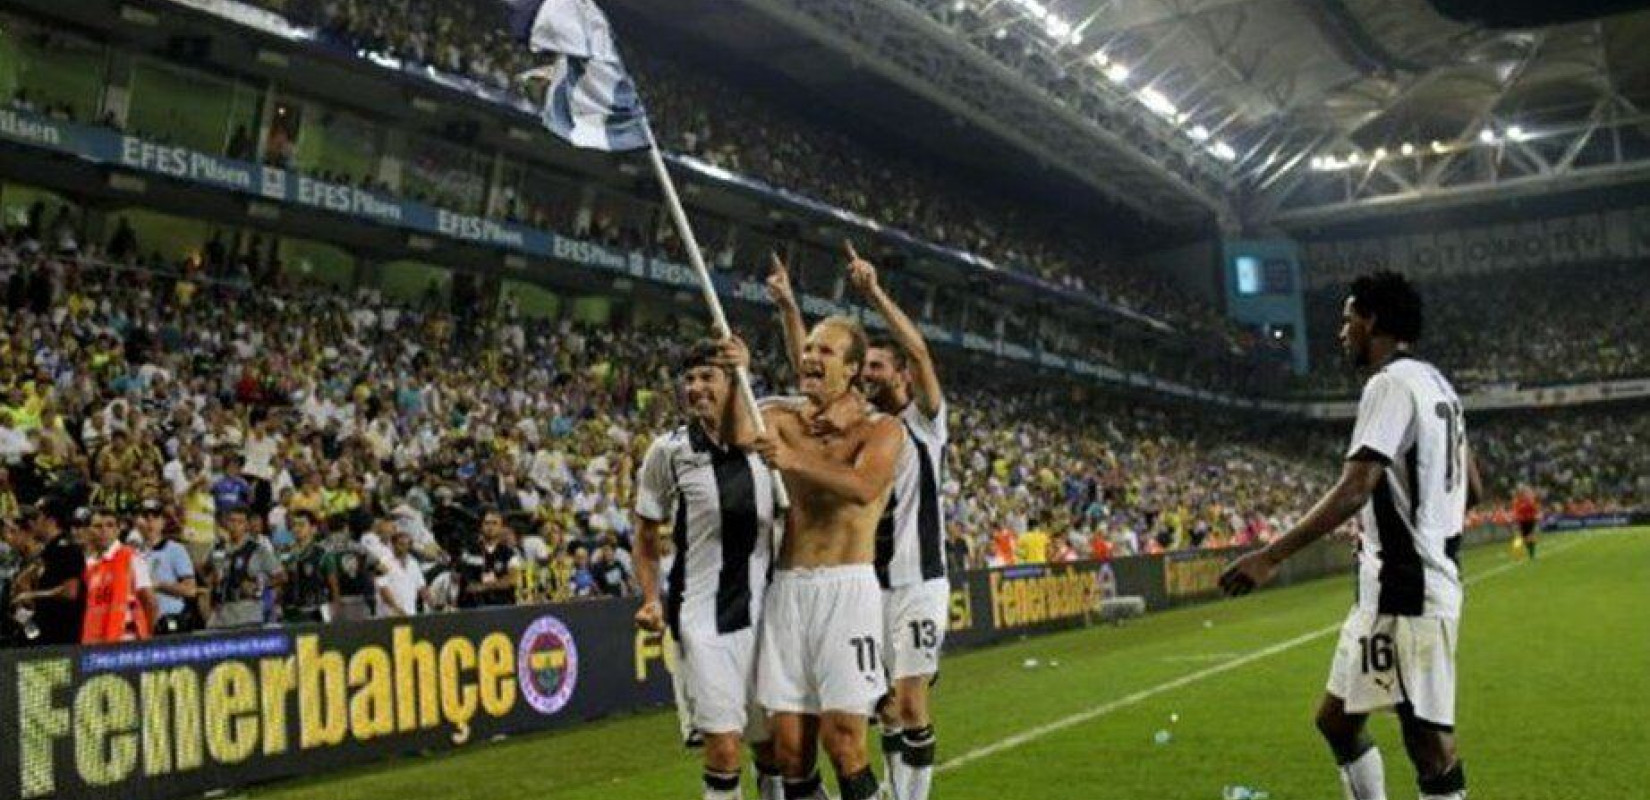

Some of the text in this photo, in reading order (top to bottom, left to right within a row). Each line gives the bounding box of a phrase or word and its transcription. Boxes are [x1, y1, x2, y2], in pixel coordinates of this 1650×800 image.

[122, 136, 187, 176] EFES
[298, 177, 350, 211] EFES
[438, 209, 482, 240] EFES
[907, 619, 938, 650] 13
[850, 636, 877, 673] 11
[1357, 633, 1393, 675] 16
[17, 625, 517, 799] Fenerbahçe
